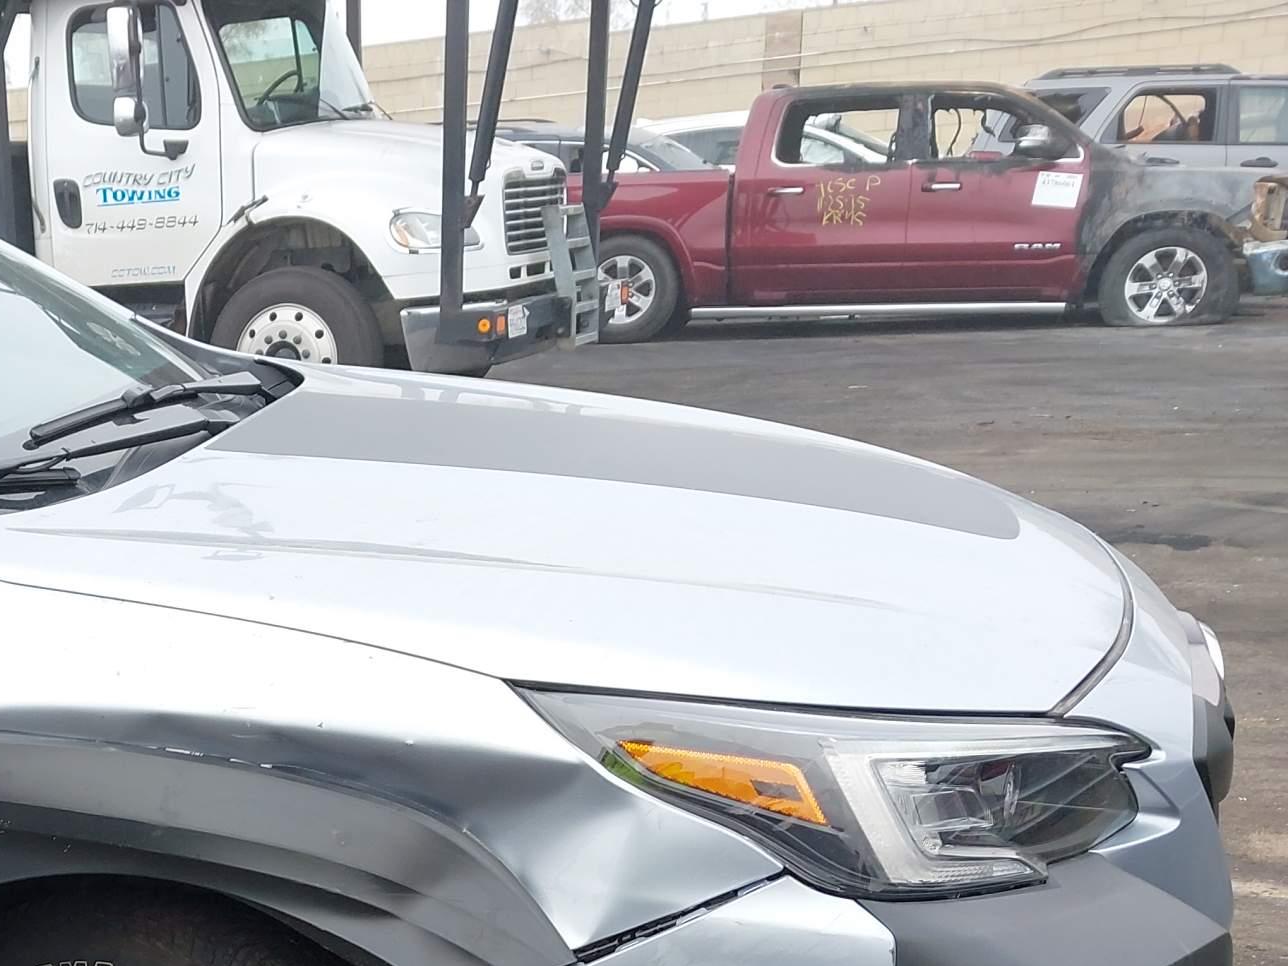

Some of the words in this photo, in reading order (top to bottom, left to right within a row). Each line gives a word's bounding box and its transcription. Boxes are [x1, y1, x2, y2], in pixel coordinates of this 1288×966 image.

[83, 170, 154, 188] COUNTRY
[157, 163, 196, 185] CITY
[96, 186, 180, 204] TOWING
[85, 215, 199, 234] 714-449-8844
